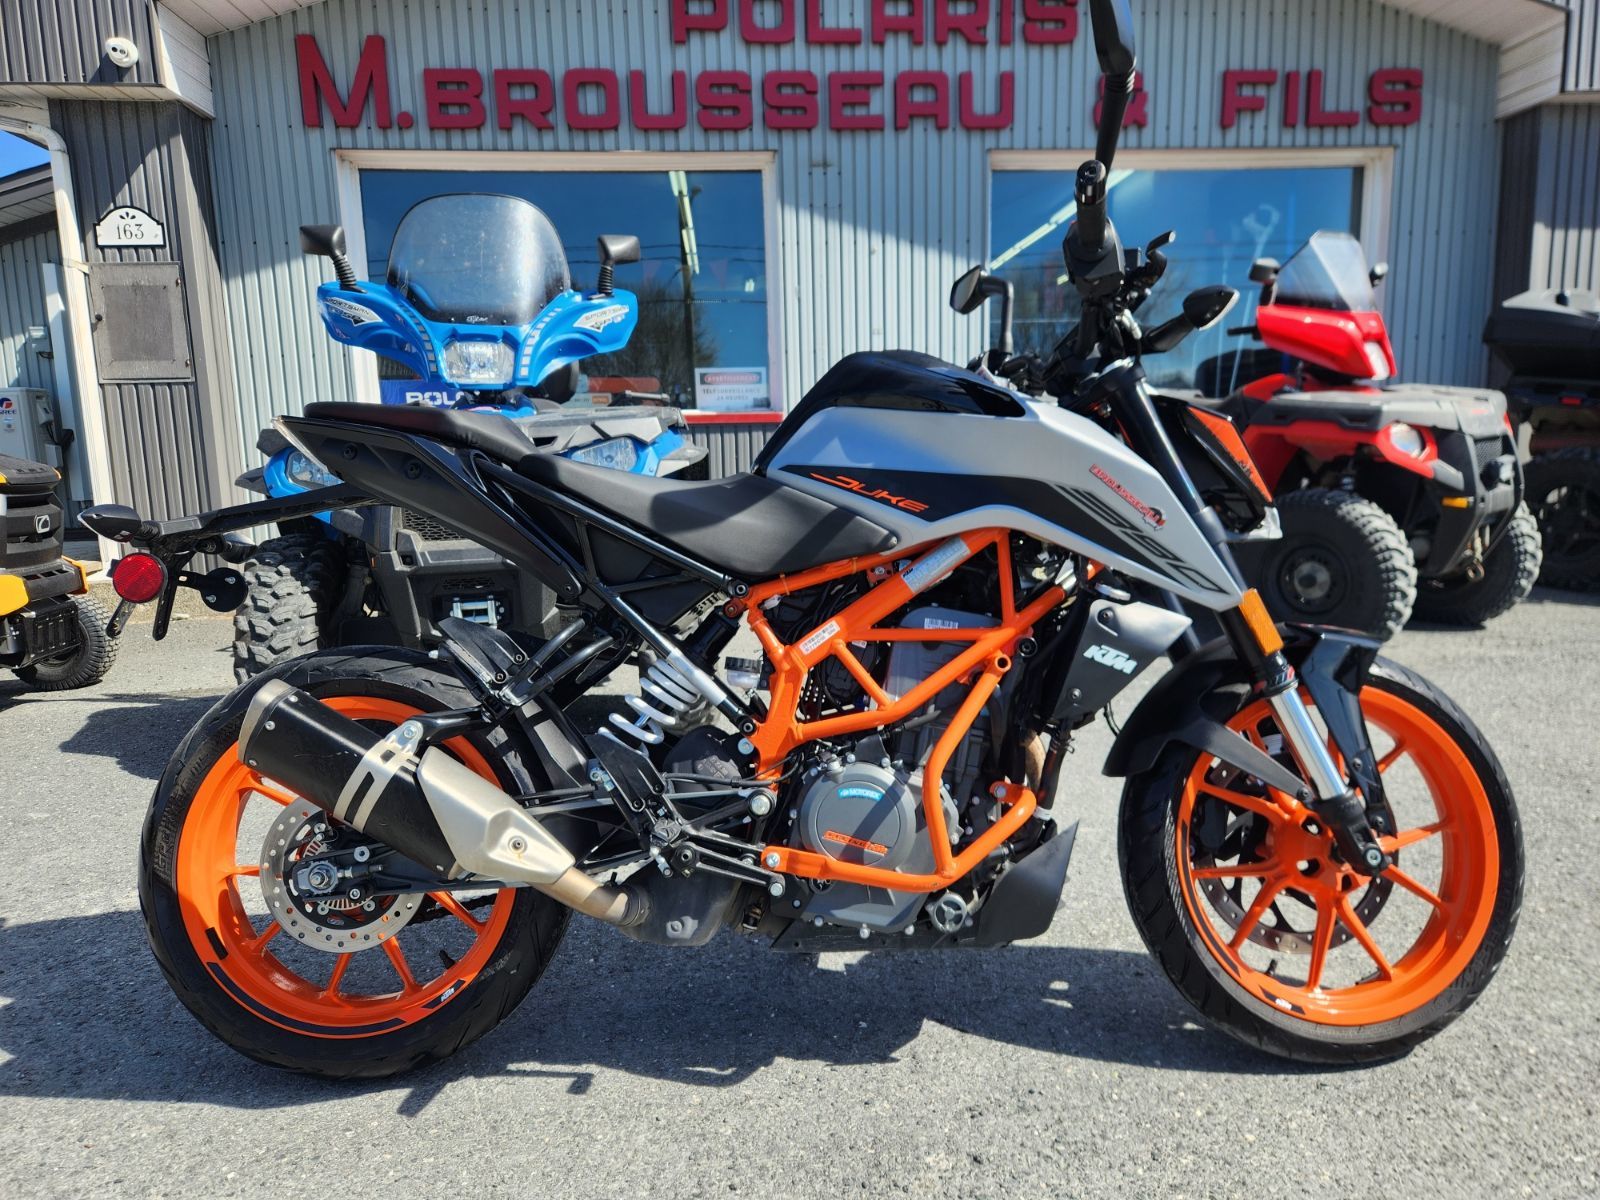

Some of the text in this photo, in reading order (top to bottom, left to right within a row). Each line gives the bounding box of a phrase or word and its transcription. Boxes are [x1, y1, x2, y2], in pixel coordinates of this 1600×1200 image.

[672, 0, 1079, 45] POLARIS
[1219, 68, 1424, 128] FILS
[116, 223, 145, 240] 163
[810, 472, 929, 513] DUKE
[1054, 483, 1231, 595] 390
[1083, 644, 1138, 675] KTM
[848, 788, 881, 800] MOTOREX
